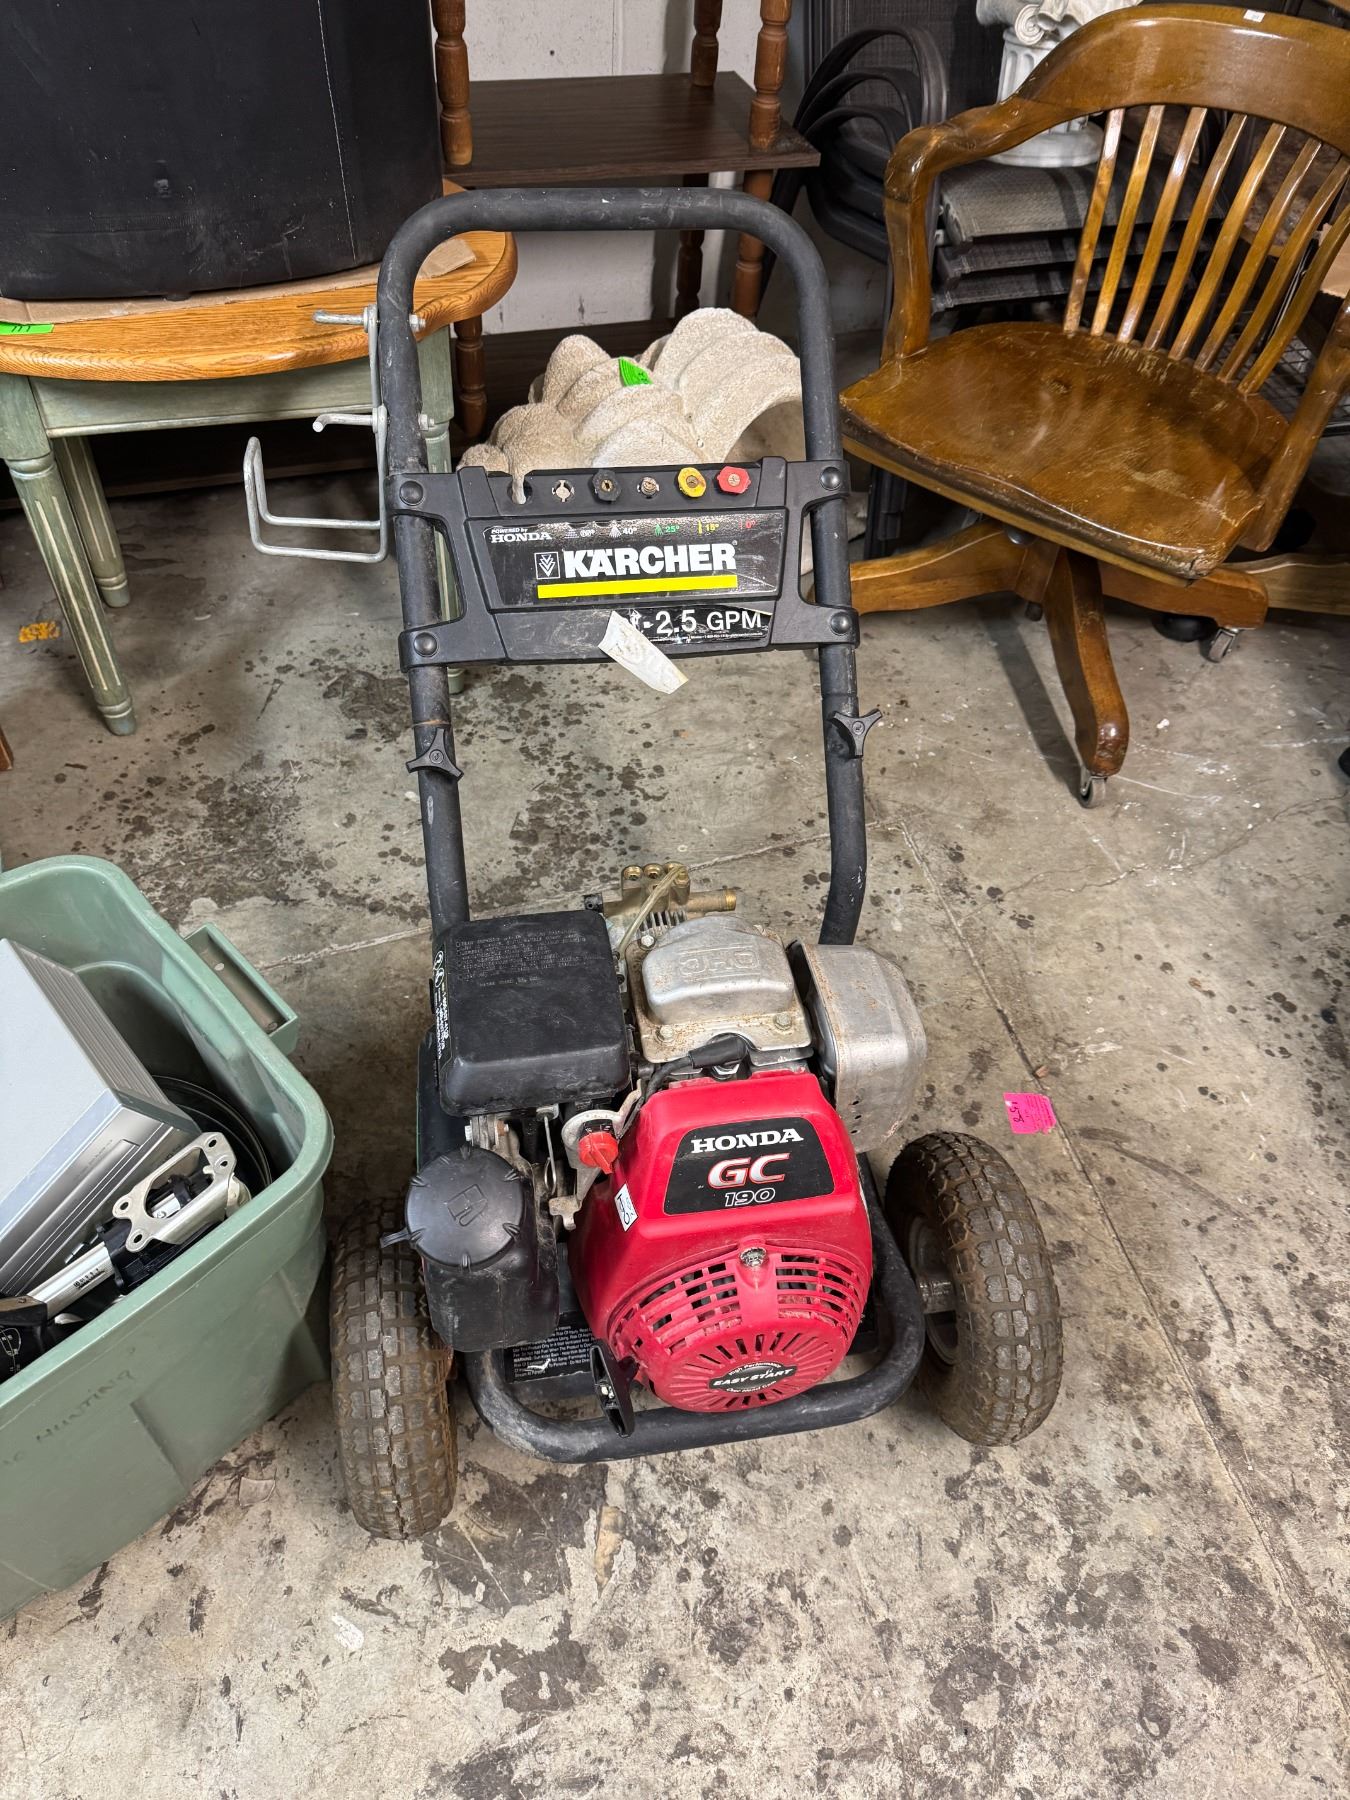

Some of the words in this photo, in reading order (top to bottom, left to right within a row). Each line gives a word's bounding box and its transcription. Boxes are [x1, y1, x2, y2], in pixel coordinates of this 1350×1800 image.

[490, 532, 553, 544] HONDA
[665, 525, 680, 533] 25°
[562, 543, 737, 578] KÄRCHER
[706, 611, 761, 631] GPM
[691, 1128, 804, 1154] HONDA
[707, 1152, 791, 1189] GC
[724, 1187, 776, 1208] 190
[713, 1375, 749, 1386] EASY
[750, 1368, 793, 1380] START
